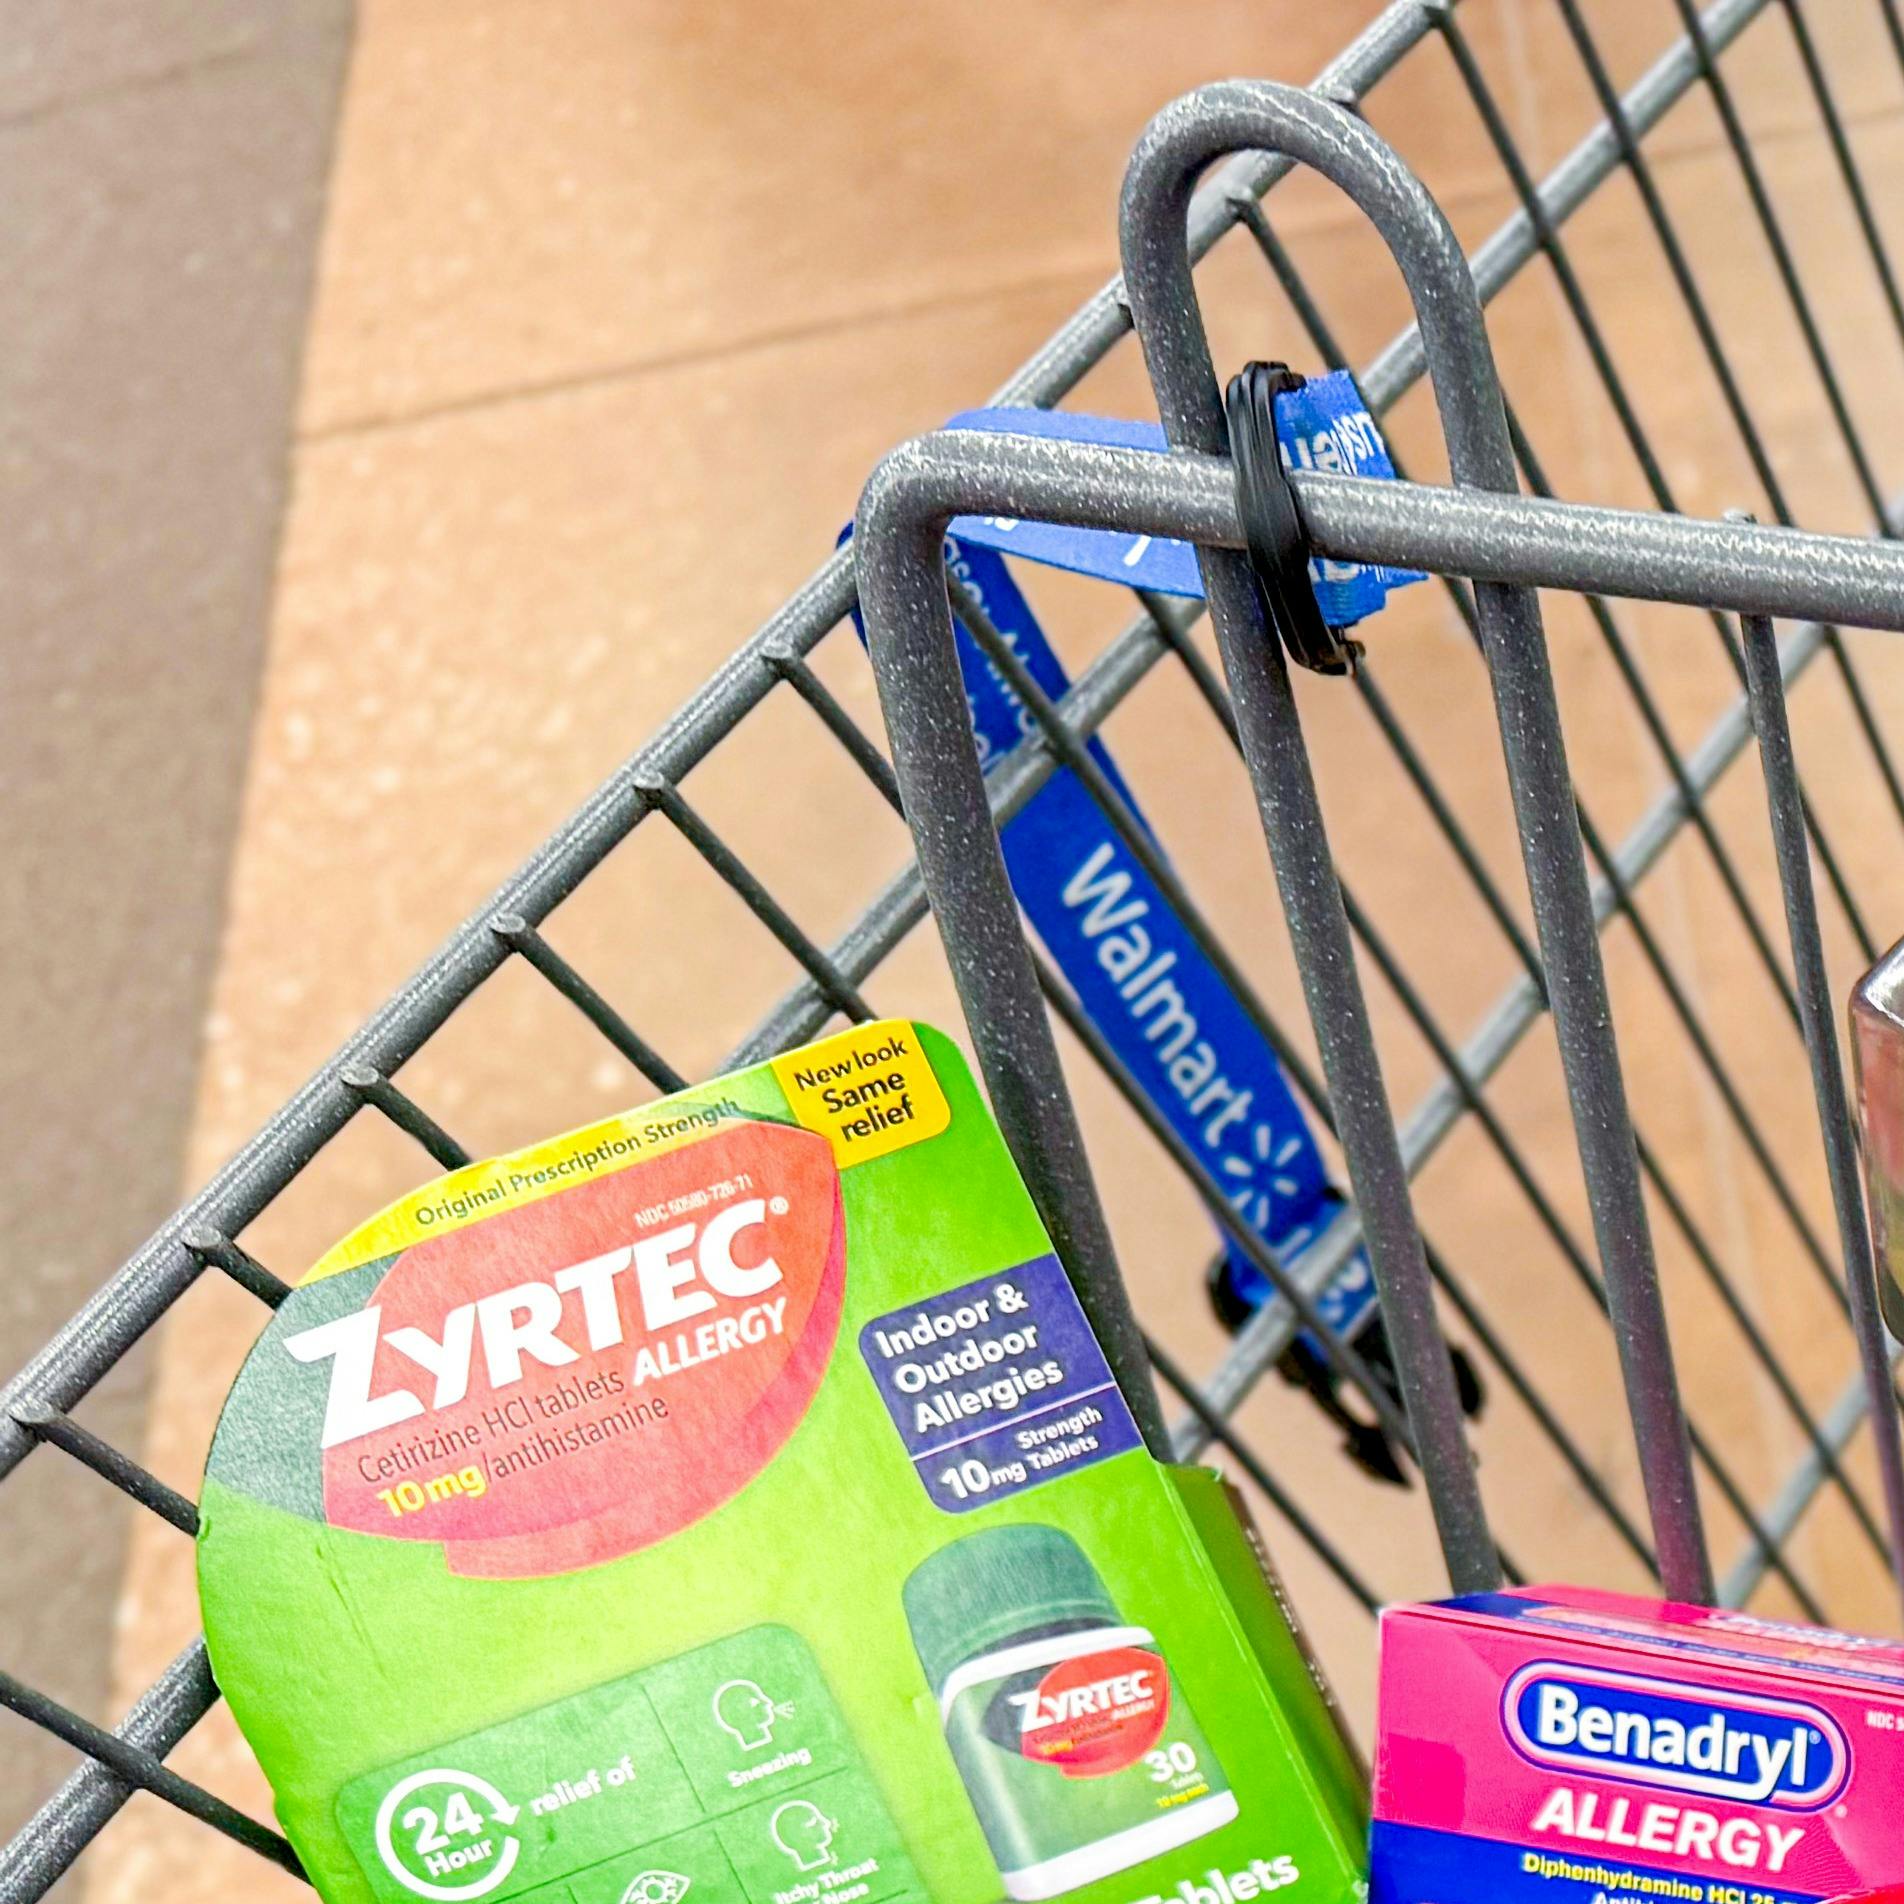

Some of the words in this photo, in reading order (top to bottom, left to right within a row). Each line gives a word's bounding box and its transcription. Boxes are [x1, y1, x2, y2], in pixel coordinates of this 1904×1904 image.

[1060, 840, 1257, 1148] Walmart
[794, 1062, 852, 1092] New
[853, 1039, 909, 1070] look
[821, 1068, 906, 1114] Same
[841, 1098, 915, 1144] relief
[415, 1179, 508, 1228] Original
[509, 1132, 642, 1194] Prescription
[643, 1095, 739, 1145] Strength
[633, 1298, 788, 1386] ALLERGY
[875, 1297, 991, 1359] Indoor
[998, 1284, 1029, 1316] &
[893, 1326, 1038, 1394] Outdoor
[358, 1424, 480, 1485] Cetirizine
[536, 1369, 625, 1420] tablets
[911, 1360, 1064, 1433] Allergies
[1016, 1407, 1104, 1450] Strength
[1029, 1436, 1099, 1474] Tablets
[529, 1771, 602, 1818] relief
[606, 1758, 637, 1789] of
[728, 1748, 812, 1790] Sneezing
[402, 1792, 483, 1856] 24
[1534, 1789, 1804, 1875] ALLERGY
[423, 1839, 494, 1880] Hour
[1522, 1853, 1702, 1904] Diphenhydramine
